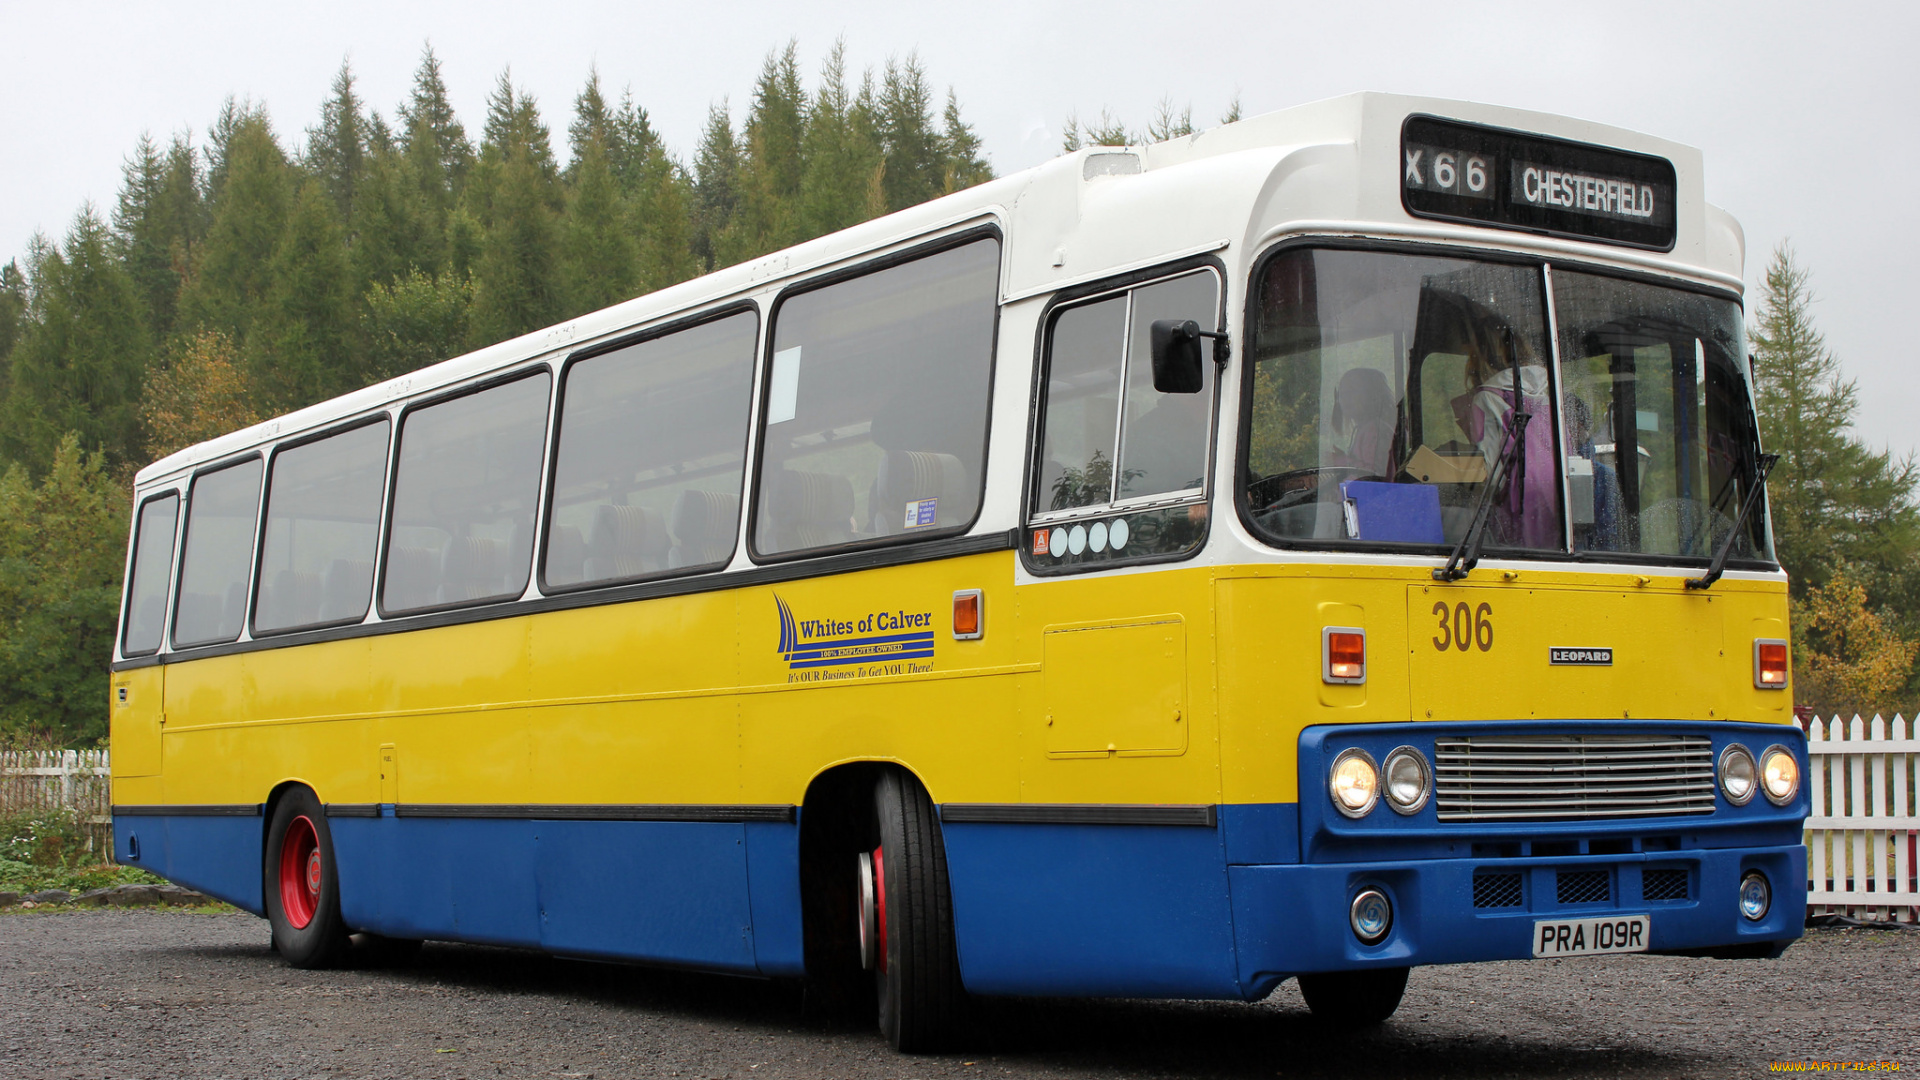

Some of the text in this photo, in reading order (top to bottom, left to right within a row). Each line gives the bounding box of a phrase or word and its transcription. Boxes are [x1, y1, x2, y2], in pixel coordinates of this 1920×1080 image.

[1523, 167, 1654, 217] CHESTERFIELD
[1037, 534, 1046, 545] A
[800, 610, 932, 638] Whites of Calver
[1432, 601, 1493, 652] 306
[820, 643, 903, 658] 100% EMPLOYEE OWNED
[1552, 650, 1611, 662] LEOPARD
[787, 661, 934, 684] It's OUR Business To Get YOU There!
[1541, 920, 1643, 953] PRA 109R
